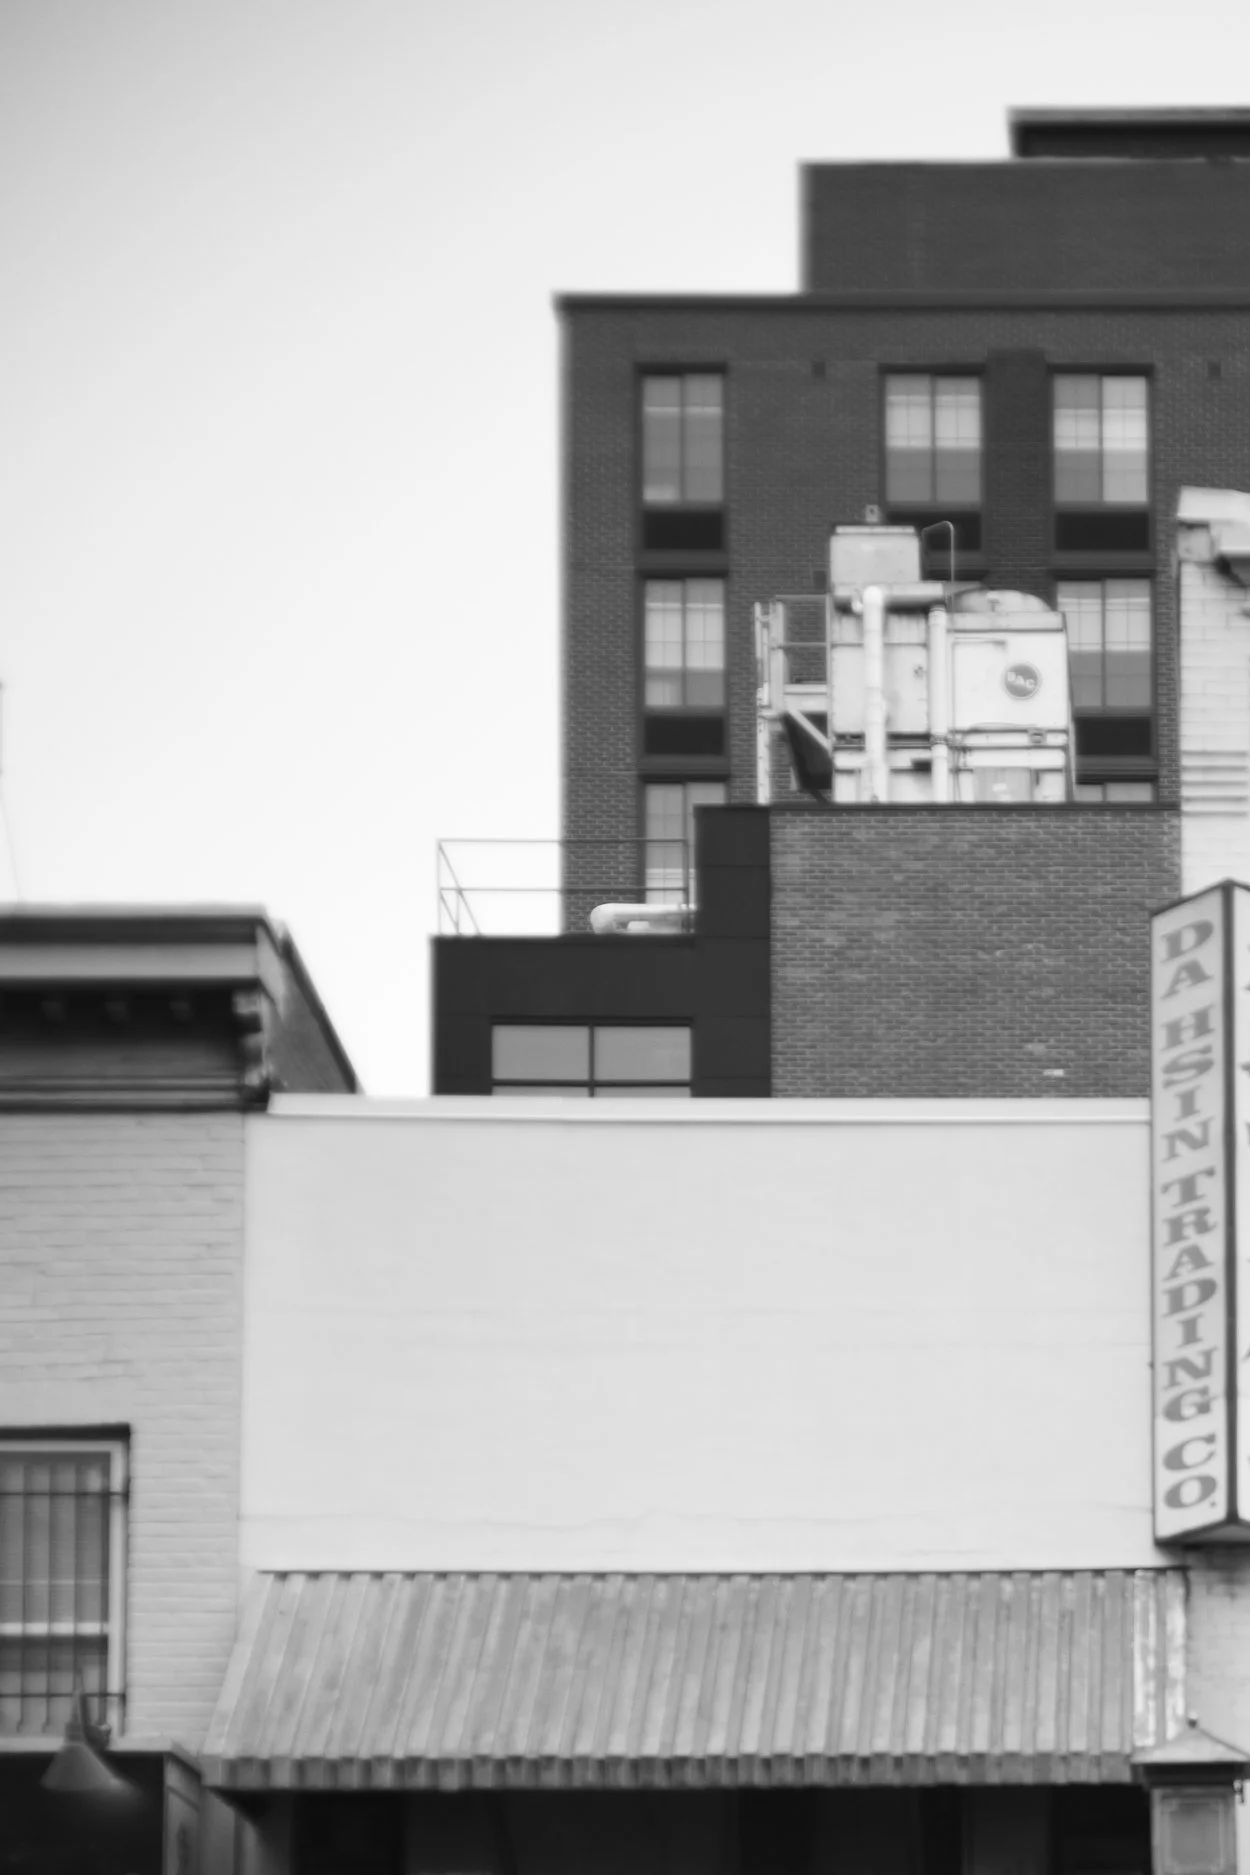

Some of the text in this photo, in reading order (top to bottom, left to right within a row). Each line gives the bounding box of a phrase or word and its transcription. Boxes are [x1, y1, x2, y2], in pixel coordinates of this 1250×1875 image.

[1161, 919, 1215, 999] DA
[1160, 1003, 1215, 1163] HSIN
[1160, 1165, 1218, 1424] TRADING
